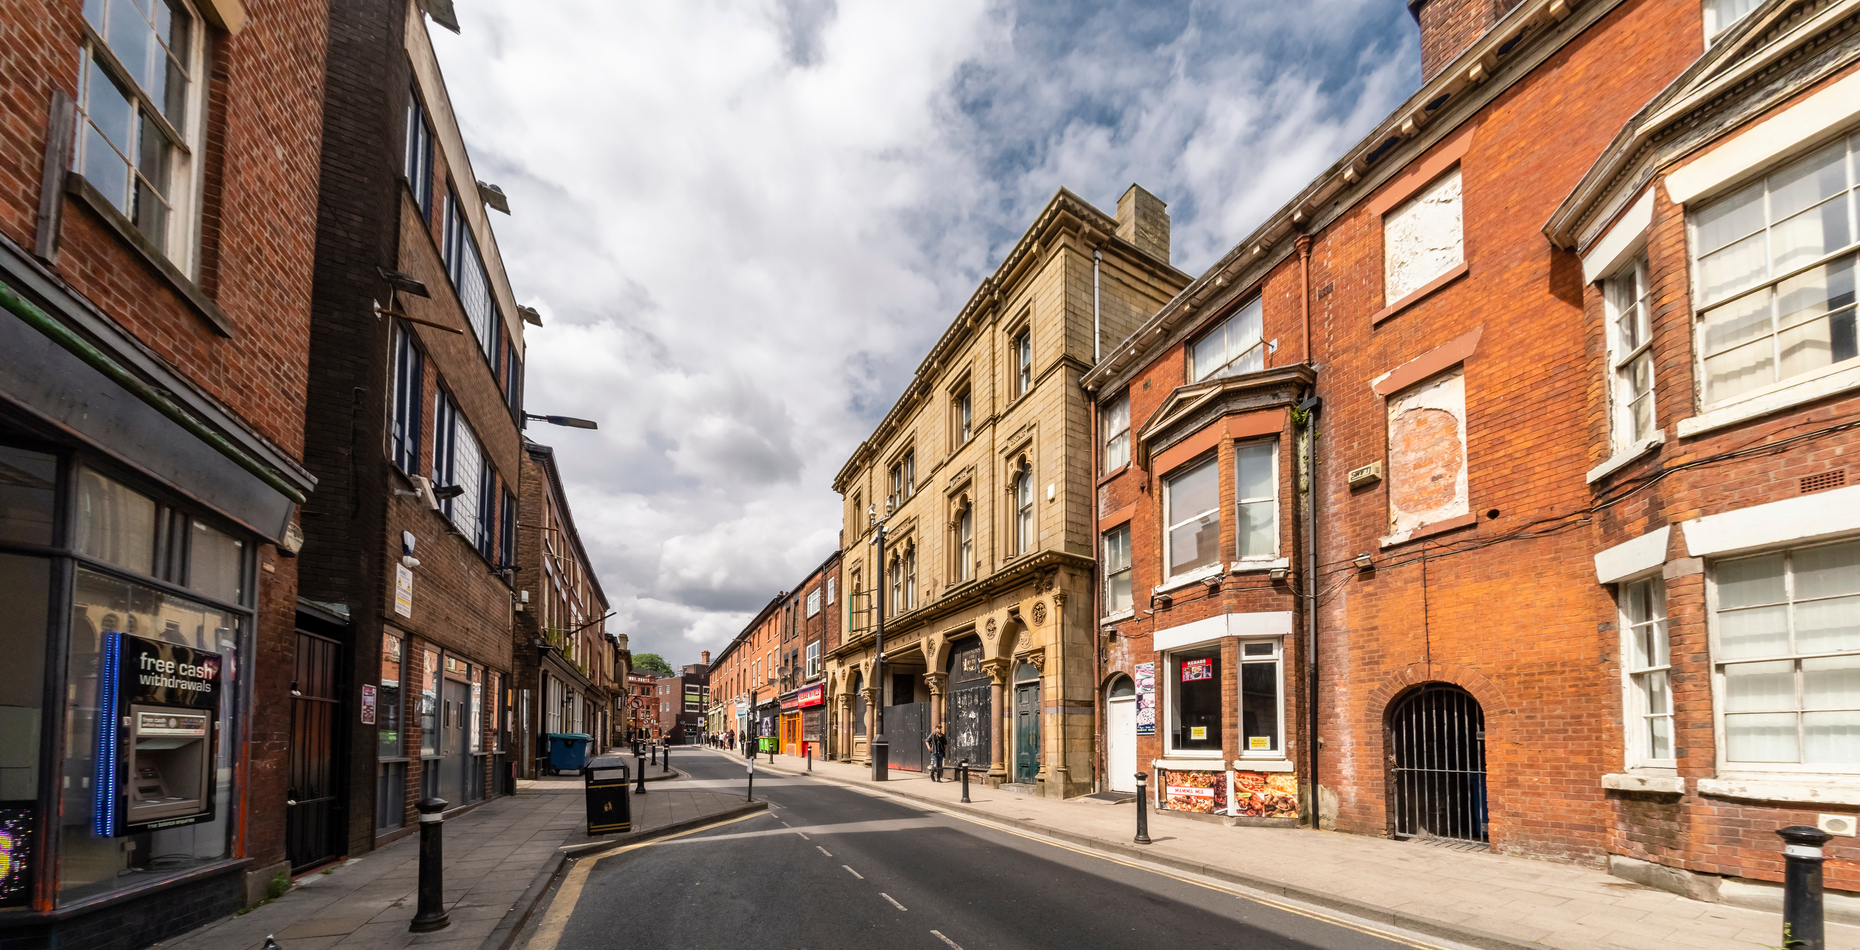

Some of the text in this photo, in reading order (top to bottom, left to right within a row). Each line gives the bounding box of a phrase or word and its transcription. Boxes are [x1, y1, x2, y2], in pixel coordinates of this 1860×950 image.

[140, 652, 212, 679] free cash
[140, 672, 211, 692] withdrawals
